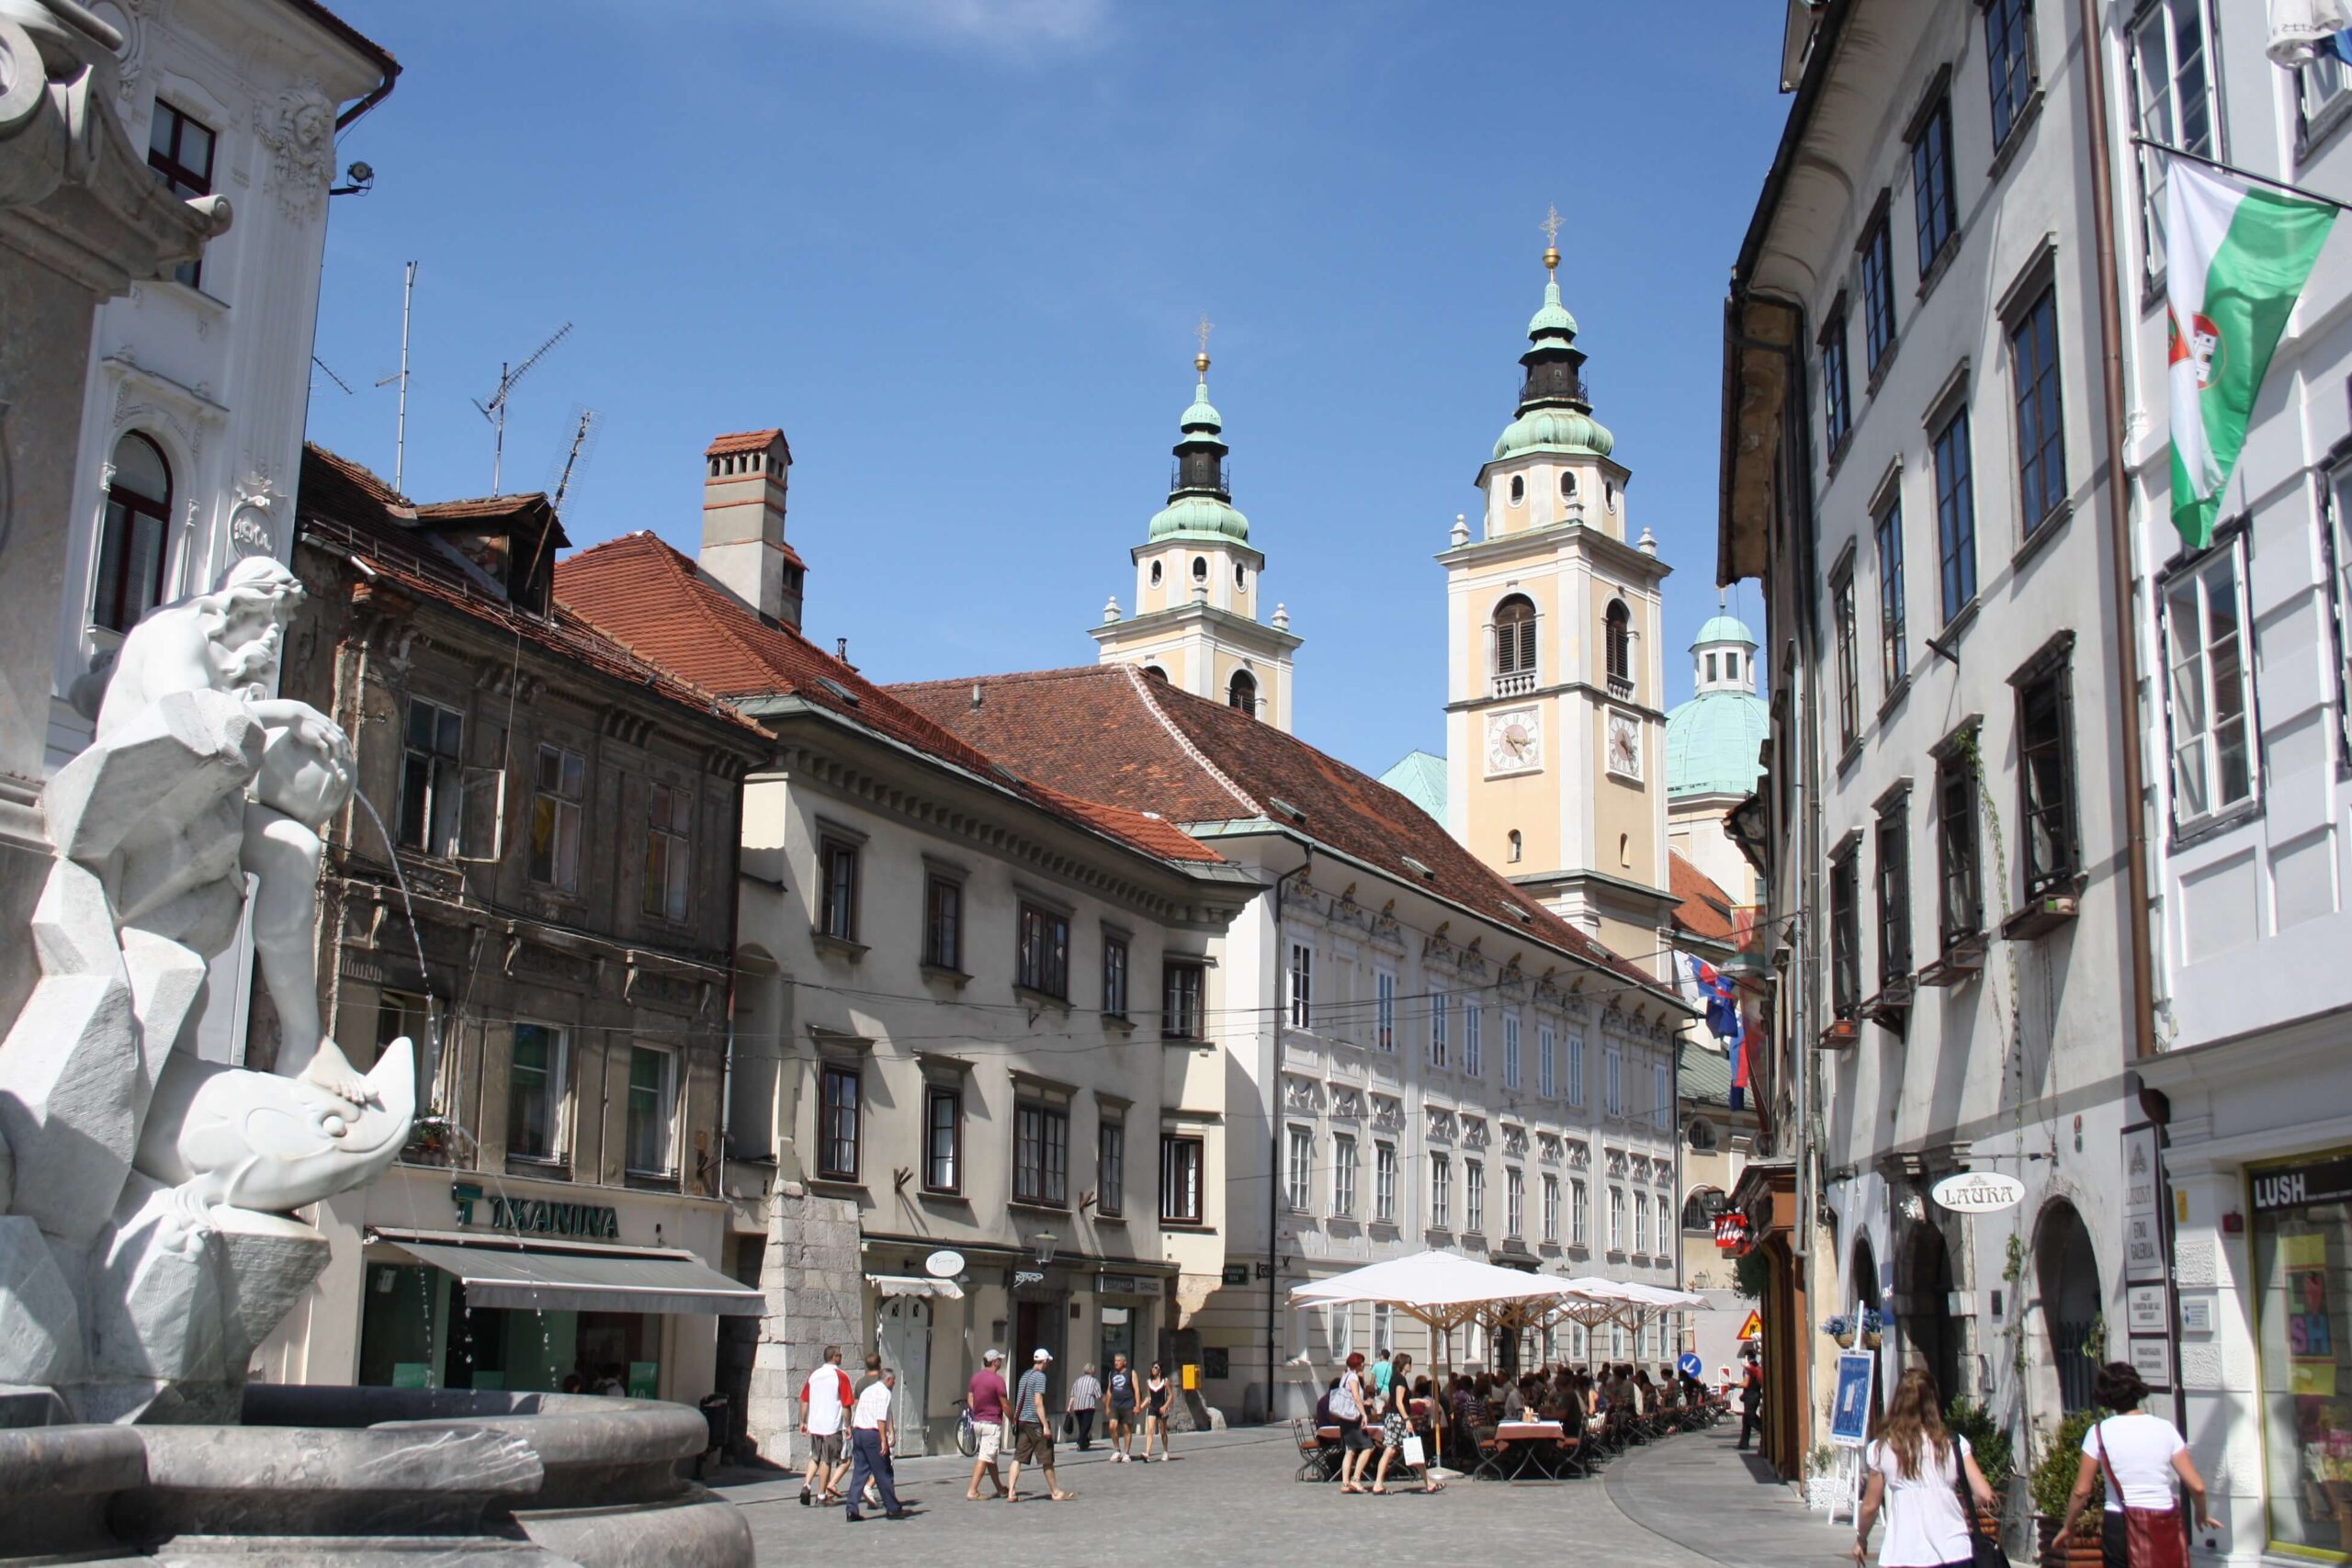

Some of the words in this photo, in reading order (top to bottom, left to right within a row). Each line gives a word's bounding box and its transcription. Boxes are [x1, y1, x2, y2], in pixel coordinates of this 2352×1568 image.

[1944, 1186, 2014, 1205] LAURA
[2255, 1173, 2305, 1208] LUSH
[488, 1195, 619, 1237] TKANINA
